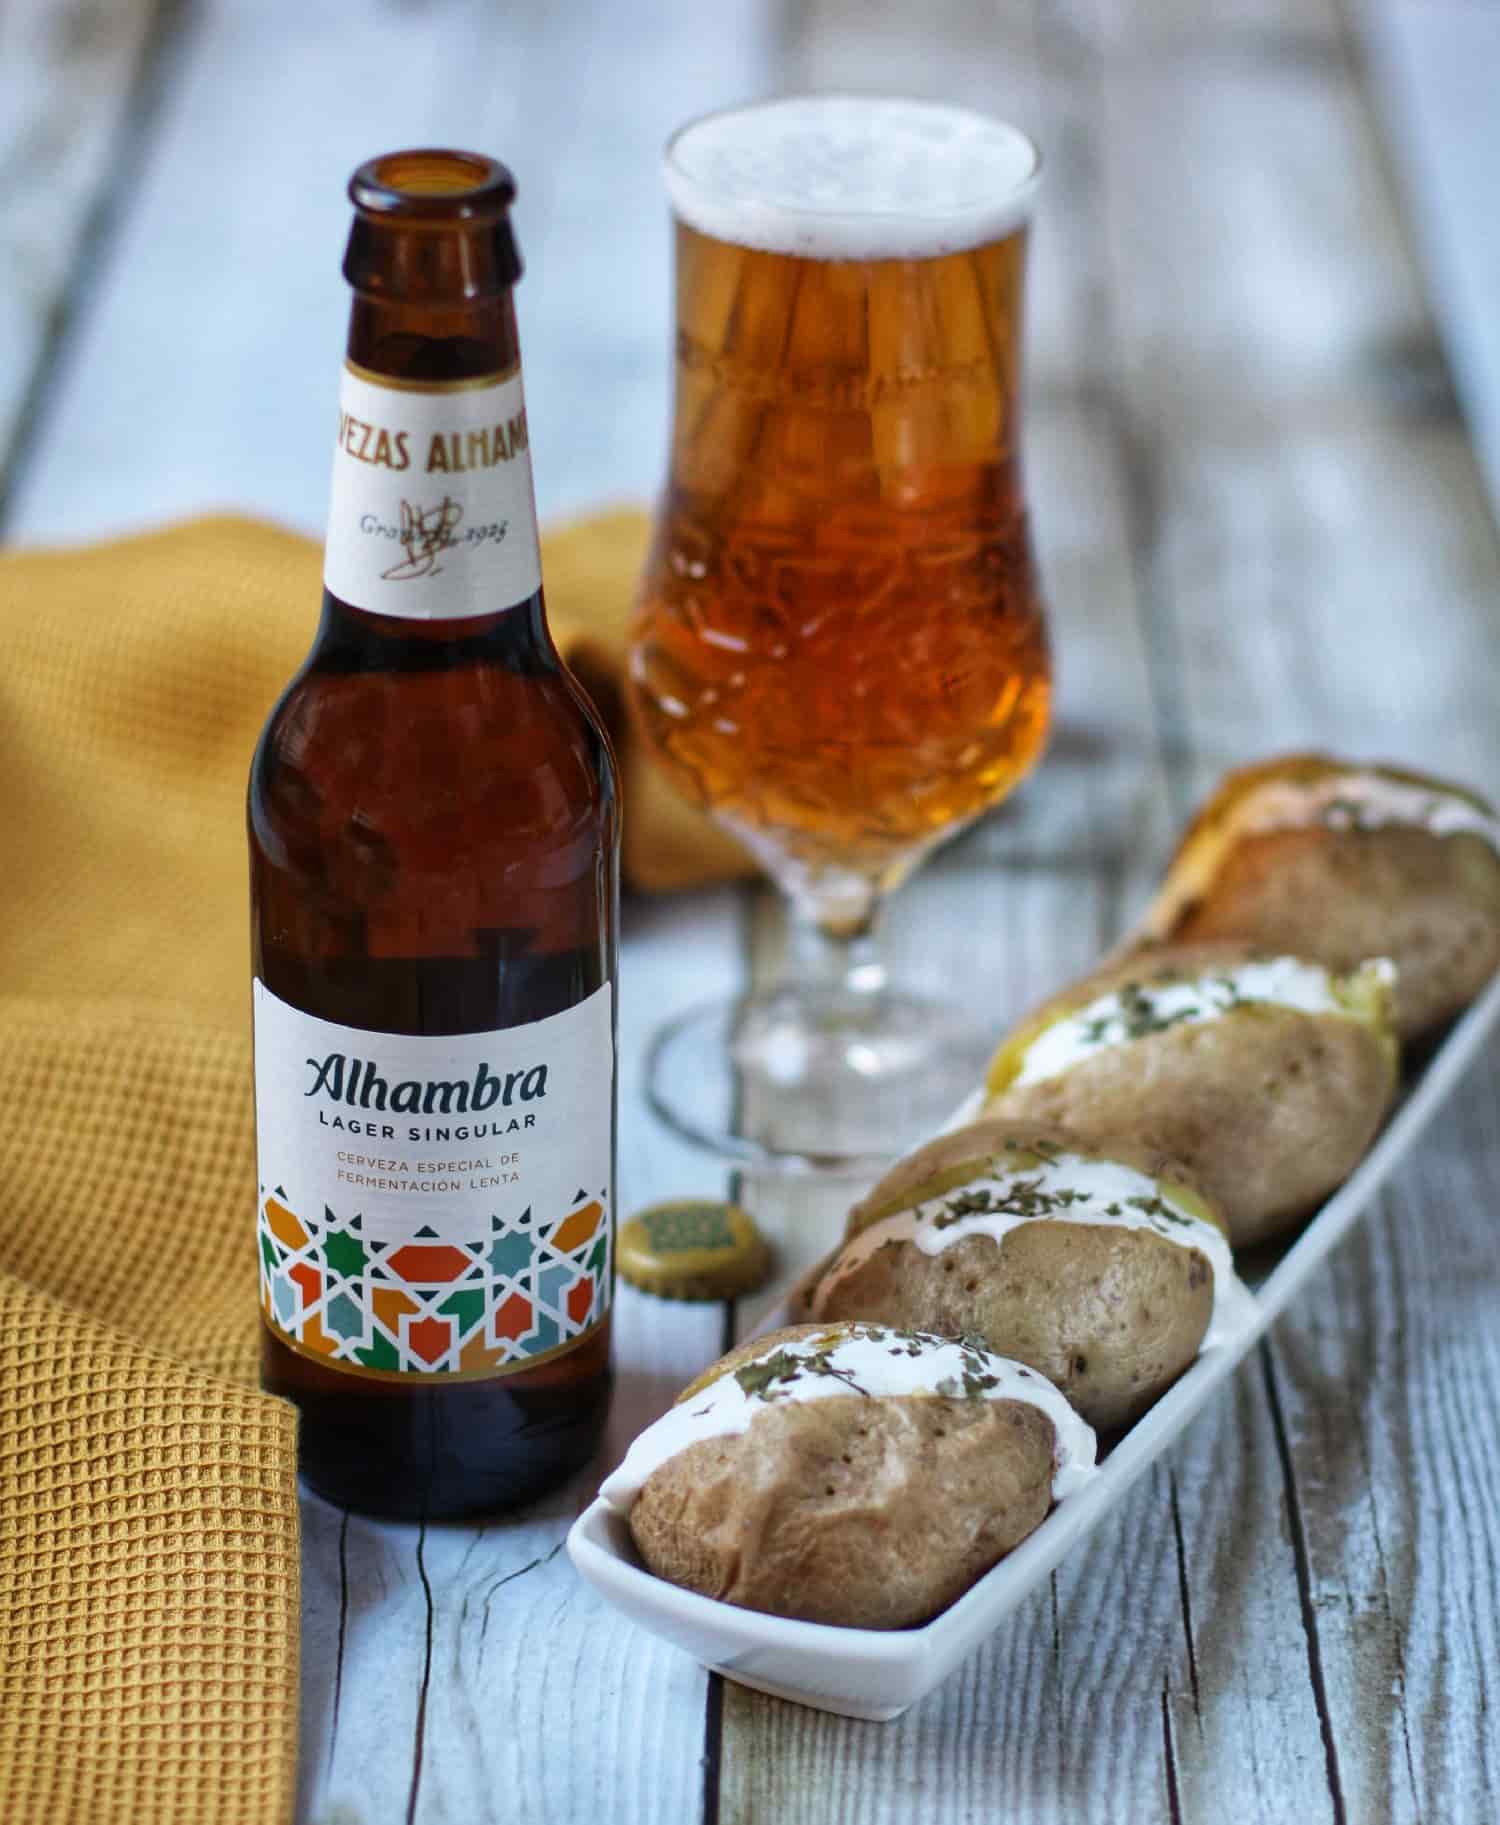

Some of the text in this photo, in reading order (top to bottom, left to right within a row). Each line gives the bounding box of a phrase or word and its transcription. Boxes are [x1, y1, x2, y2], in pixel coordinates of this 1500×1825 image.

[304, 1053, 548, 1115] Alhambra
[319, 1110, 536, 1142] LAGER SINGULAR
[337, 1151, 520, 1174] CERVEZA ESPECIAL DE
[470, 1171, 520, 1189] LENTA
